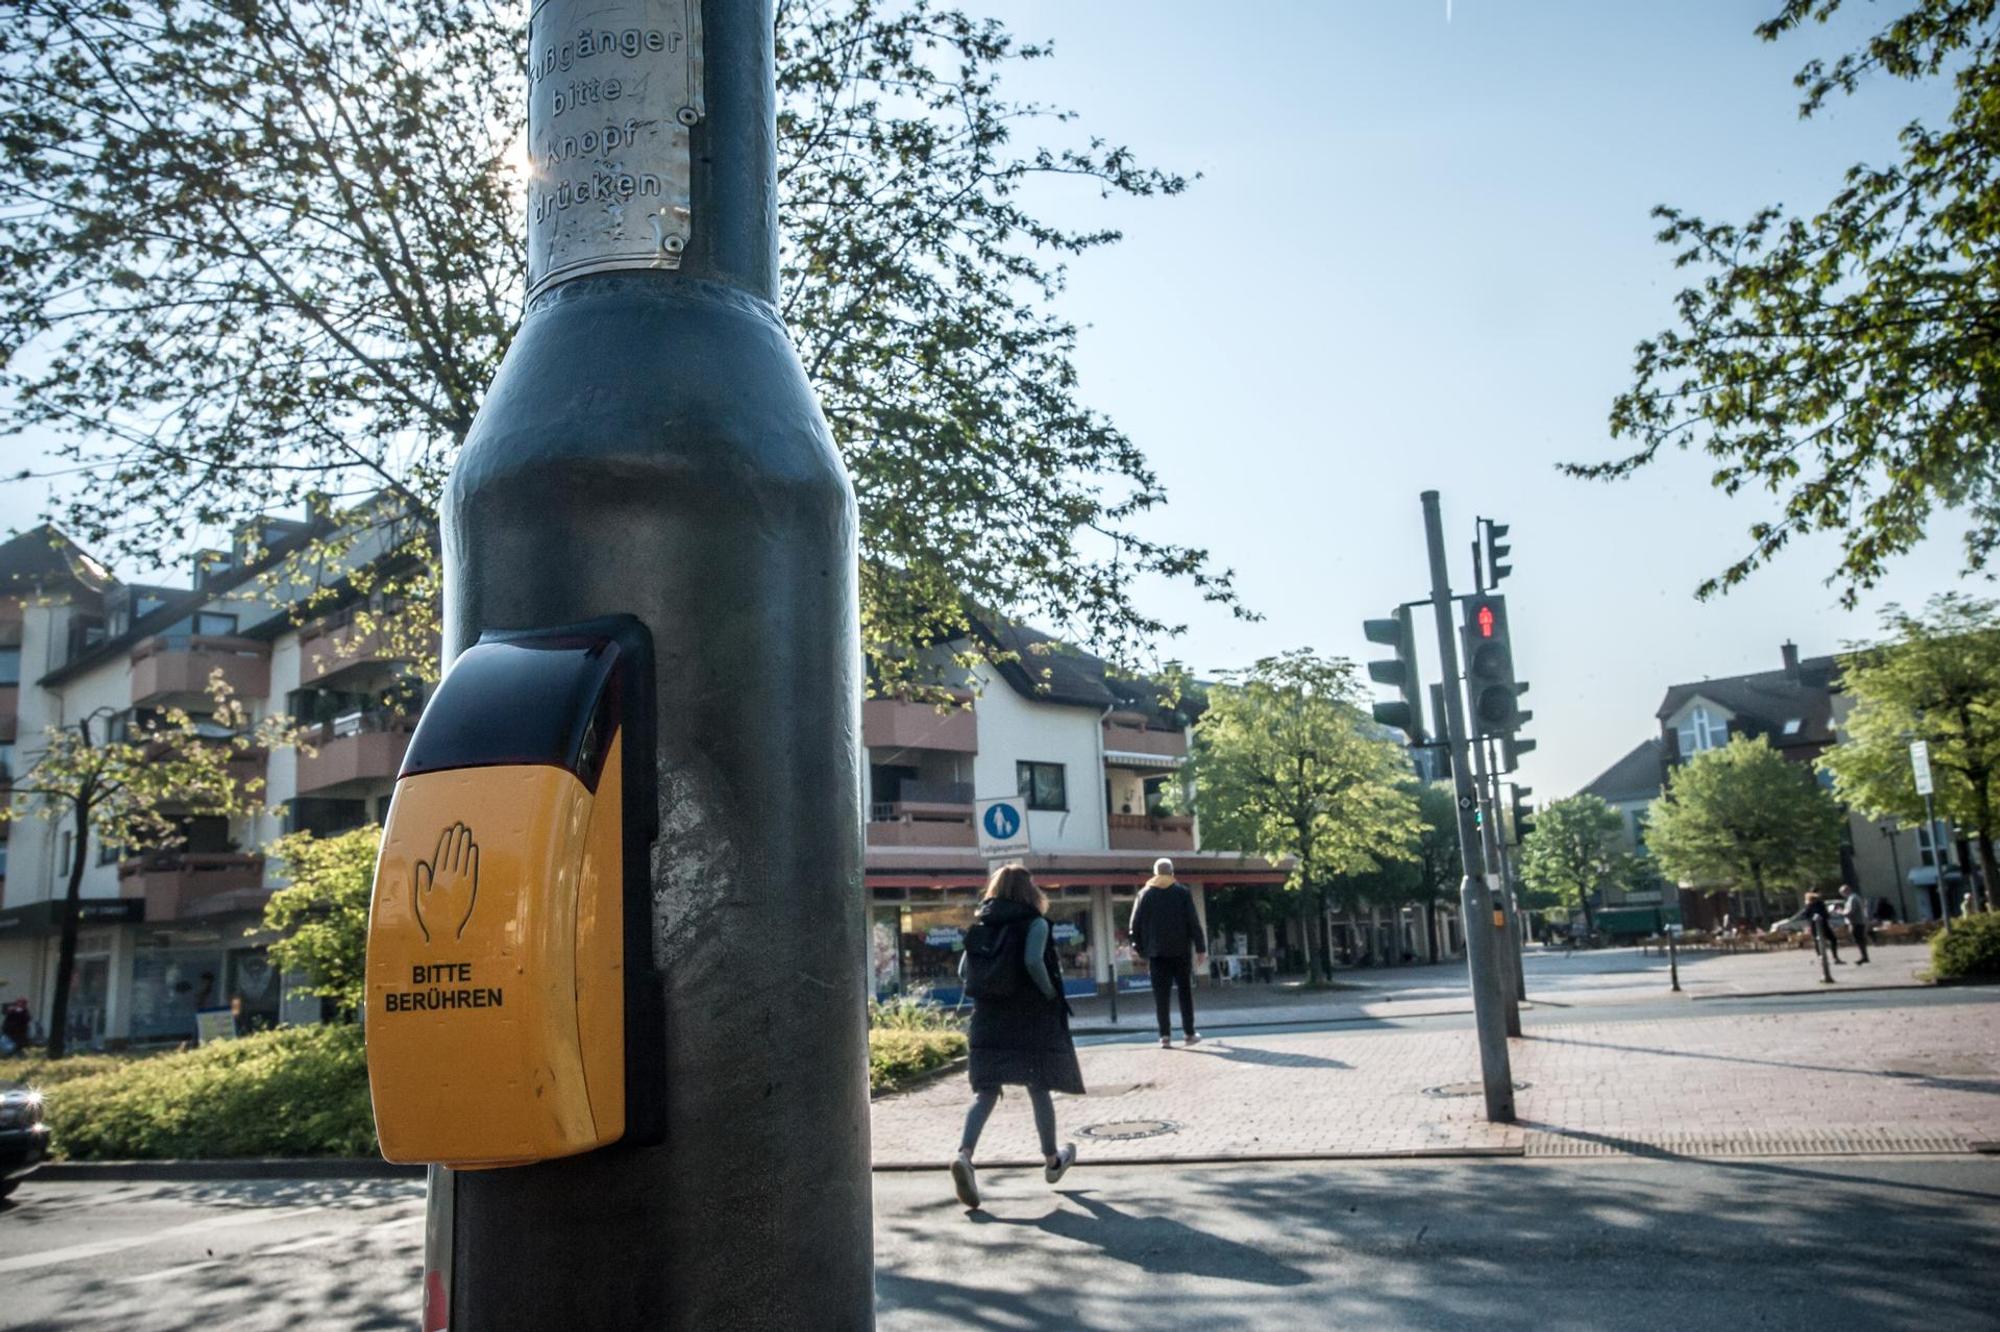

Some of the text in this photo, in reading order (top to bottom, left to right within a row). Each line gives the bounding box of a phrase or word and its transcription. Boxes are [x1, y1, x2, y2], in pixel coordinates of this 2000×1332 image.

[552, 77, 622, 117] bitte
[535, 171, 661, 225] drücken
[412, 963, 471, 984] BITTE
[385, 987, 503, 1012] BERÜHREN
